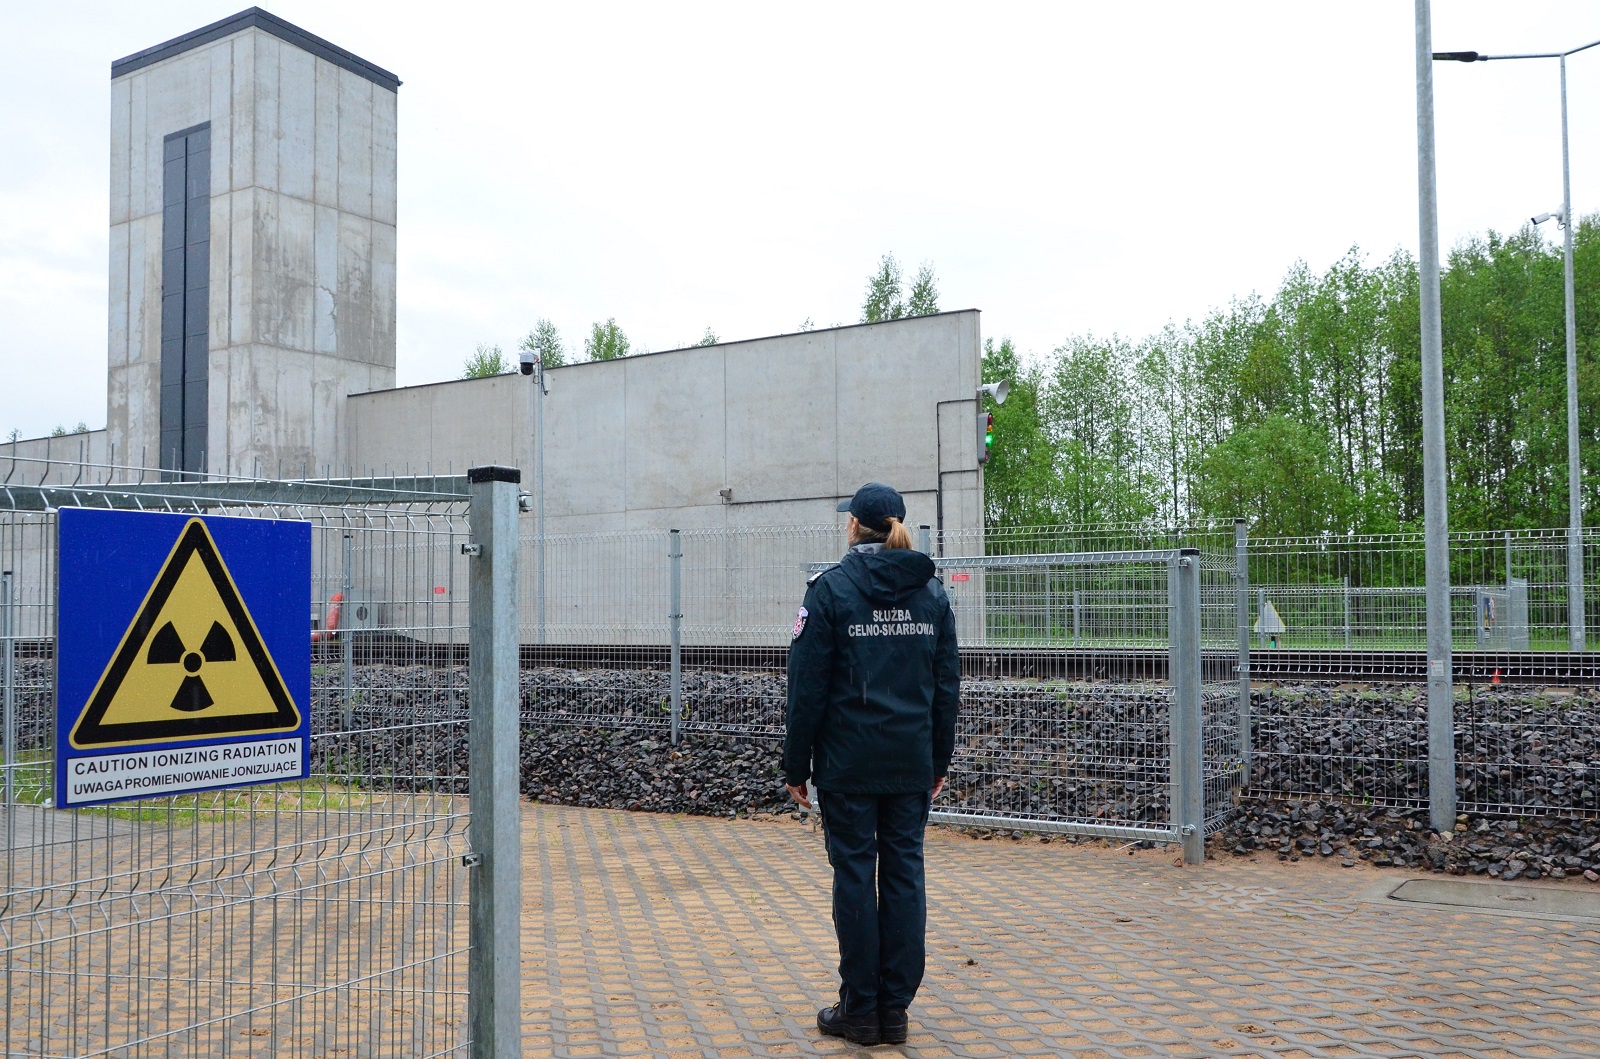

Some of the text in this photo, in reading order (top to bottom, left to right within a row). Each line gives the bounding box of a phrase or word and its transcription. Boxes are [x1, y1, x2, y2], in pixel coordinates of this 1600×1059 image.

[873, 607, 912, 622] SŁUŻBA
[848, 622, 934, 637] CELNO-SKARBOWA
[75, 742, 297, 775] CAUTION IONIZING RADIATION
[74, 761, 297, 795] UWAGA PROMIENIOWANIE JONIZUJĄCE
